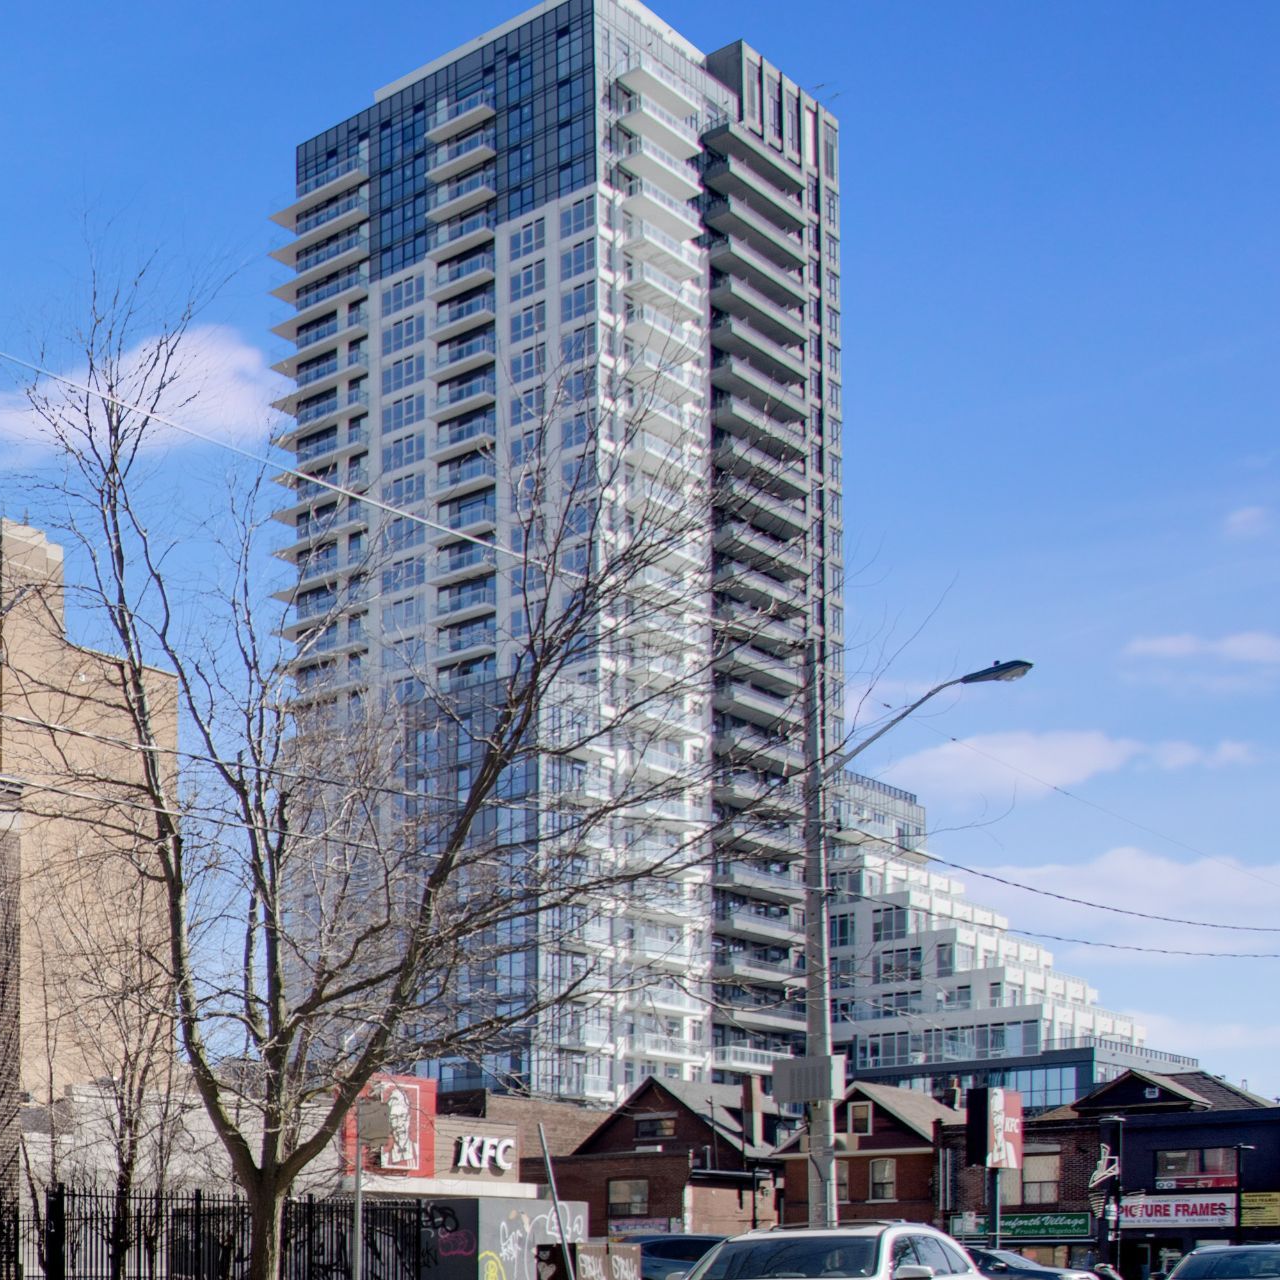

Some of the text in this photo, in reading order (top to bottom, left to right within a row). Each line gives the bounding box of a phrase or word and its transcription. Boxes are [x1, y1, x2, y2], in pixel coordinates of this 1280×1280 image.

[1004, 1117, 1020, 1133] KFC
[457, 1136, 514, 1170] KFC
[1175, 1202, 1227, 1217] FRAMES
[1000, 1215, 1086, 1228] anforth Village
